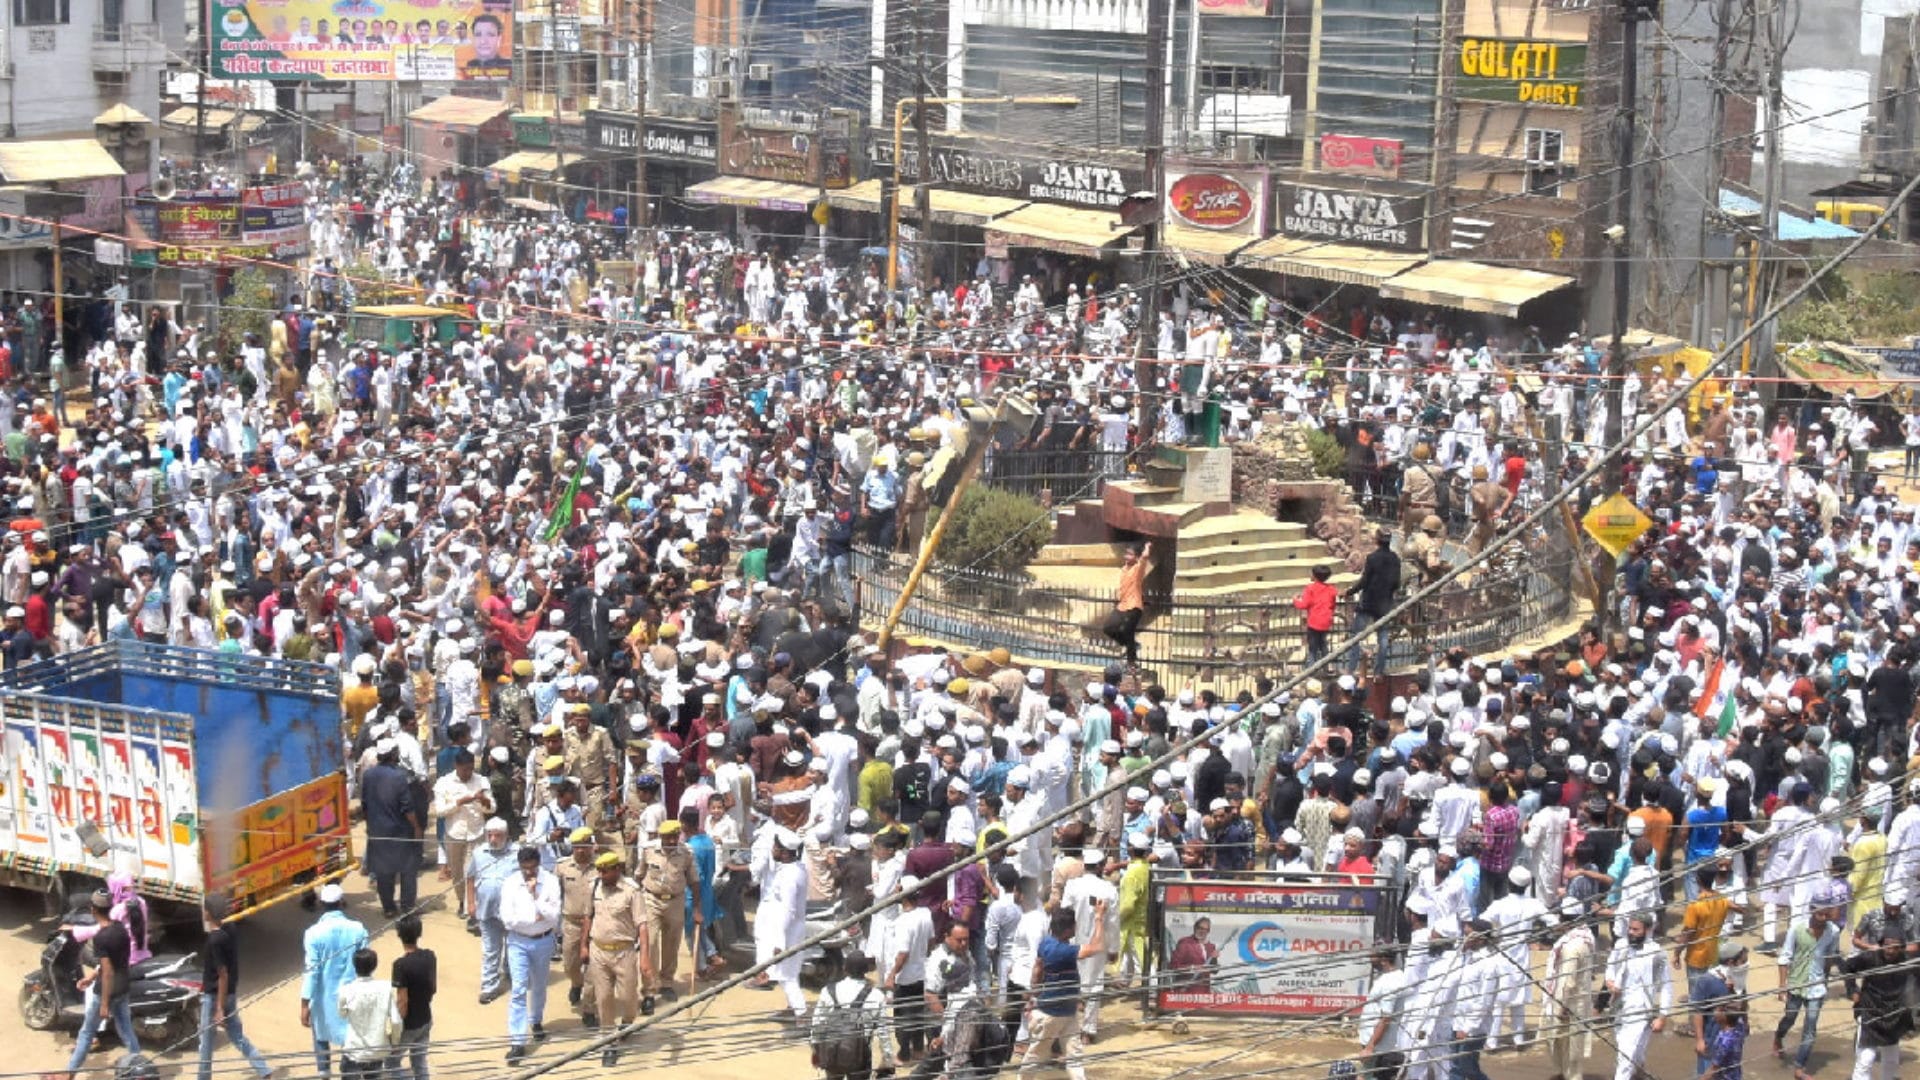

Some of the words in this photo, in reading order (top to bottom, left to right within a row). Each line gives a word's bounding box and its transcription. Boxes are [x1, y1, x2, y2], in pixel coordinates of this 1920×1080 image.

[221, 53, 262, 73] गरीब
[265, 59, 326, 73] कल्याण
[331, 59, 388, 74] जनसभा
[1461, 39, 1558, 80] GULATI
[1518, 81, 1578, 106] DAIRY
[1043, 161, 1127, 194] JANTA
[1194, 189, 1242, 210] STAR
[1294, 189, 1399, 226] JANTA
[1285, 216, 1337, 235] BAKERS
[1340, 222, 1352, 239] &
[1352, 223, 1409, 245] SWEETS
[1290, 891, 1341, 909] पुलिस
